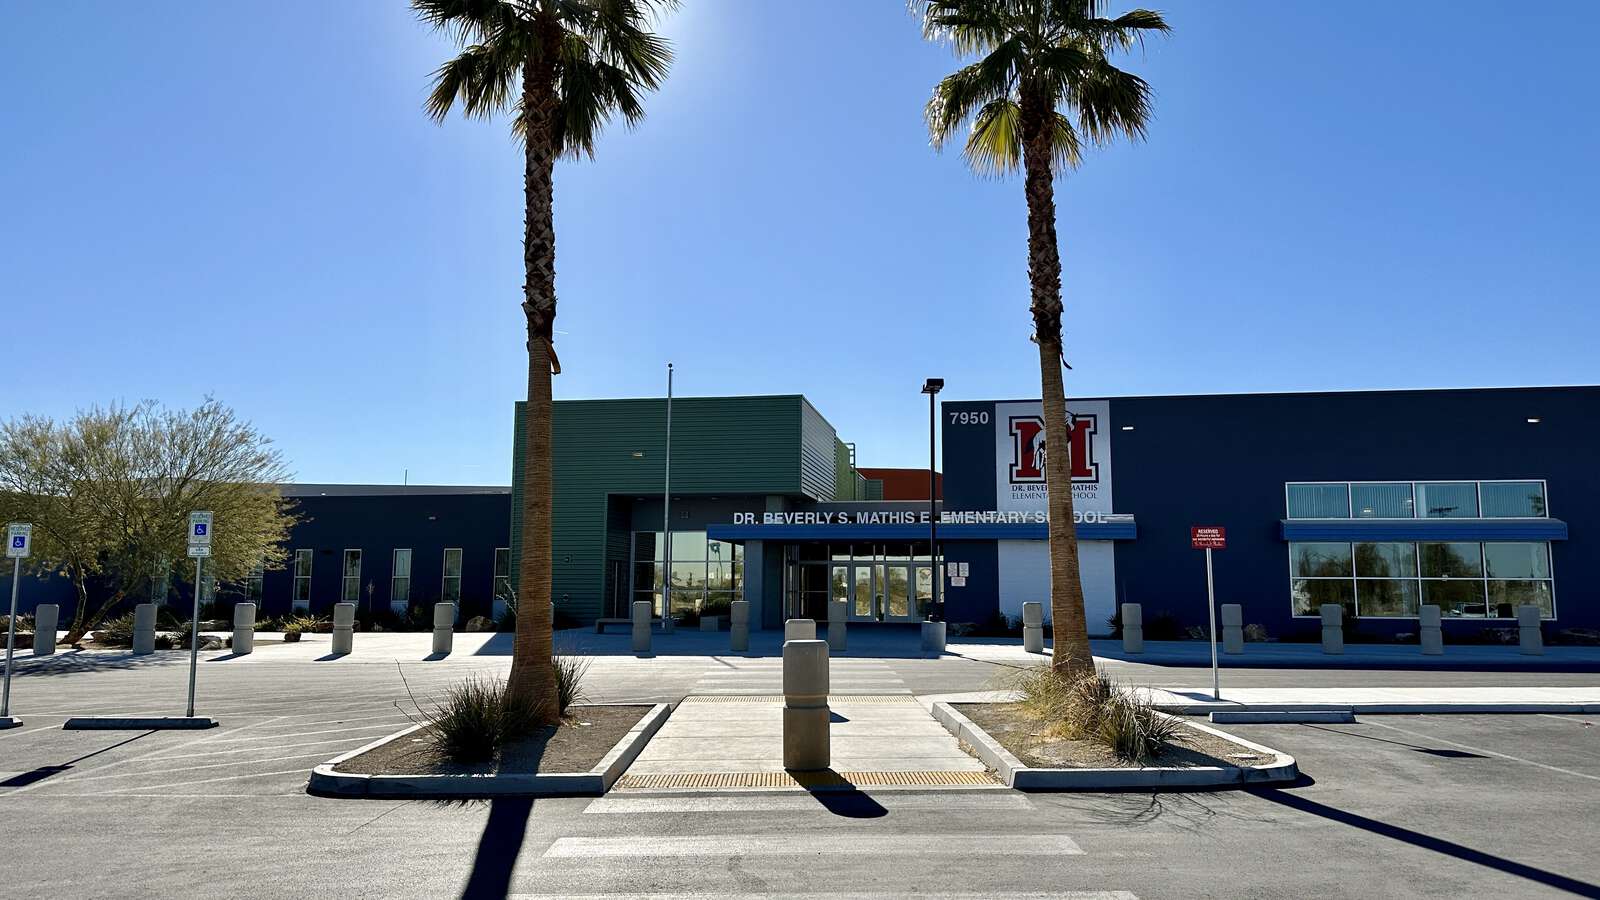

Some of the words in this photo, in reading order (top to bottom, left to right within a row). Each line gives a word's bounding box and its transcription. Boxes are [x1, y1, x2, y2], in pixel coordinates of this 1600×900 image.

[949, 411, 989, 425] 7950
[1011, 484, 1025, 492] DR.
[1027, 484, 1048, 492] BEVE
[1012, 492, 1047, 500] ELEMENT
[1073, 492, 1097, 500] HOOL
[733, 512, 759, 525] DR.
[763, 512, 834, 525] BEVERLY
[838, 511, 852, 525] S.
[856, 511, 916, 525] MATHIS
[1034, 510, 1108, 524] SOOL
